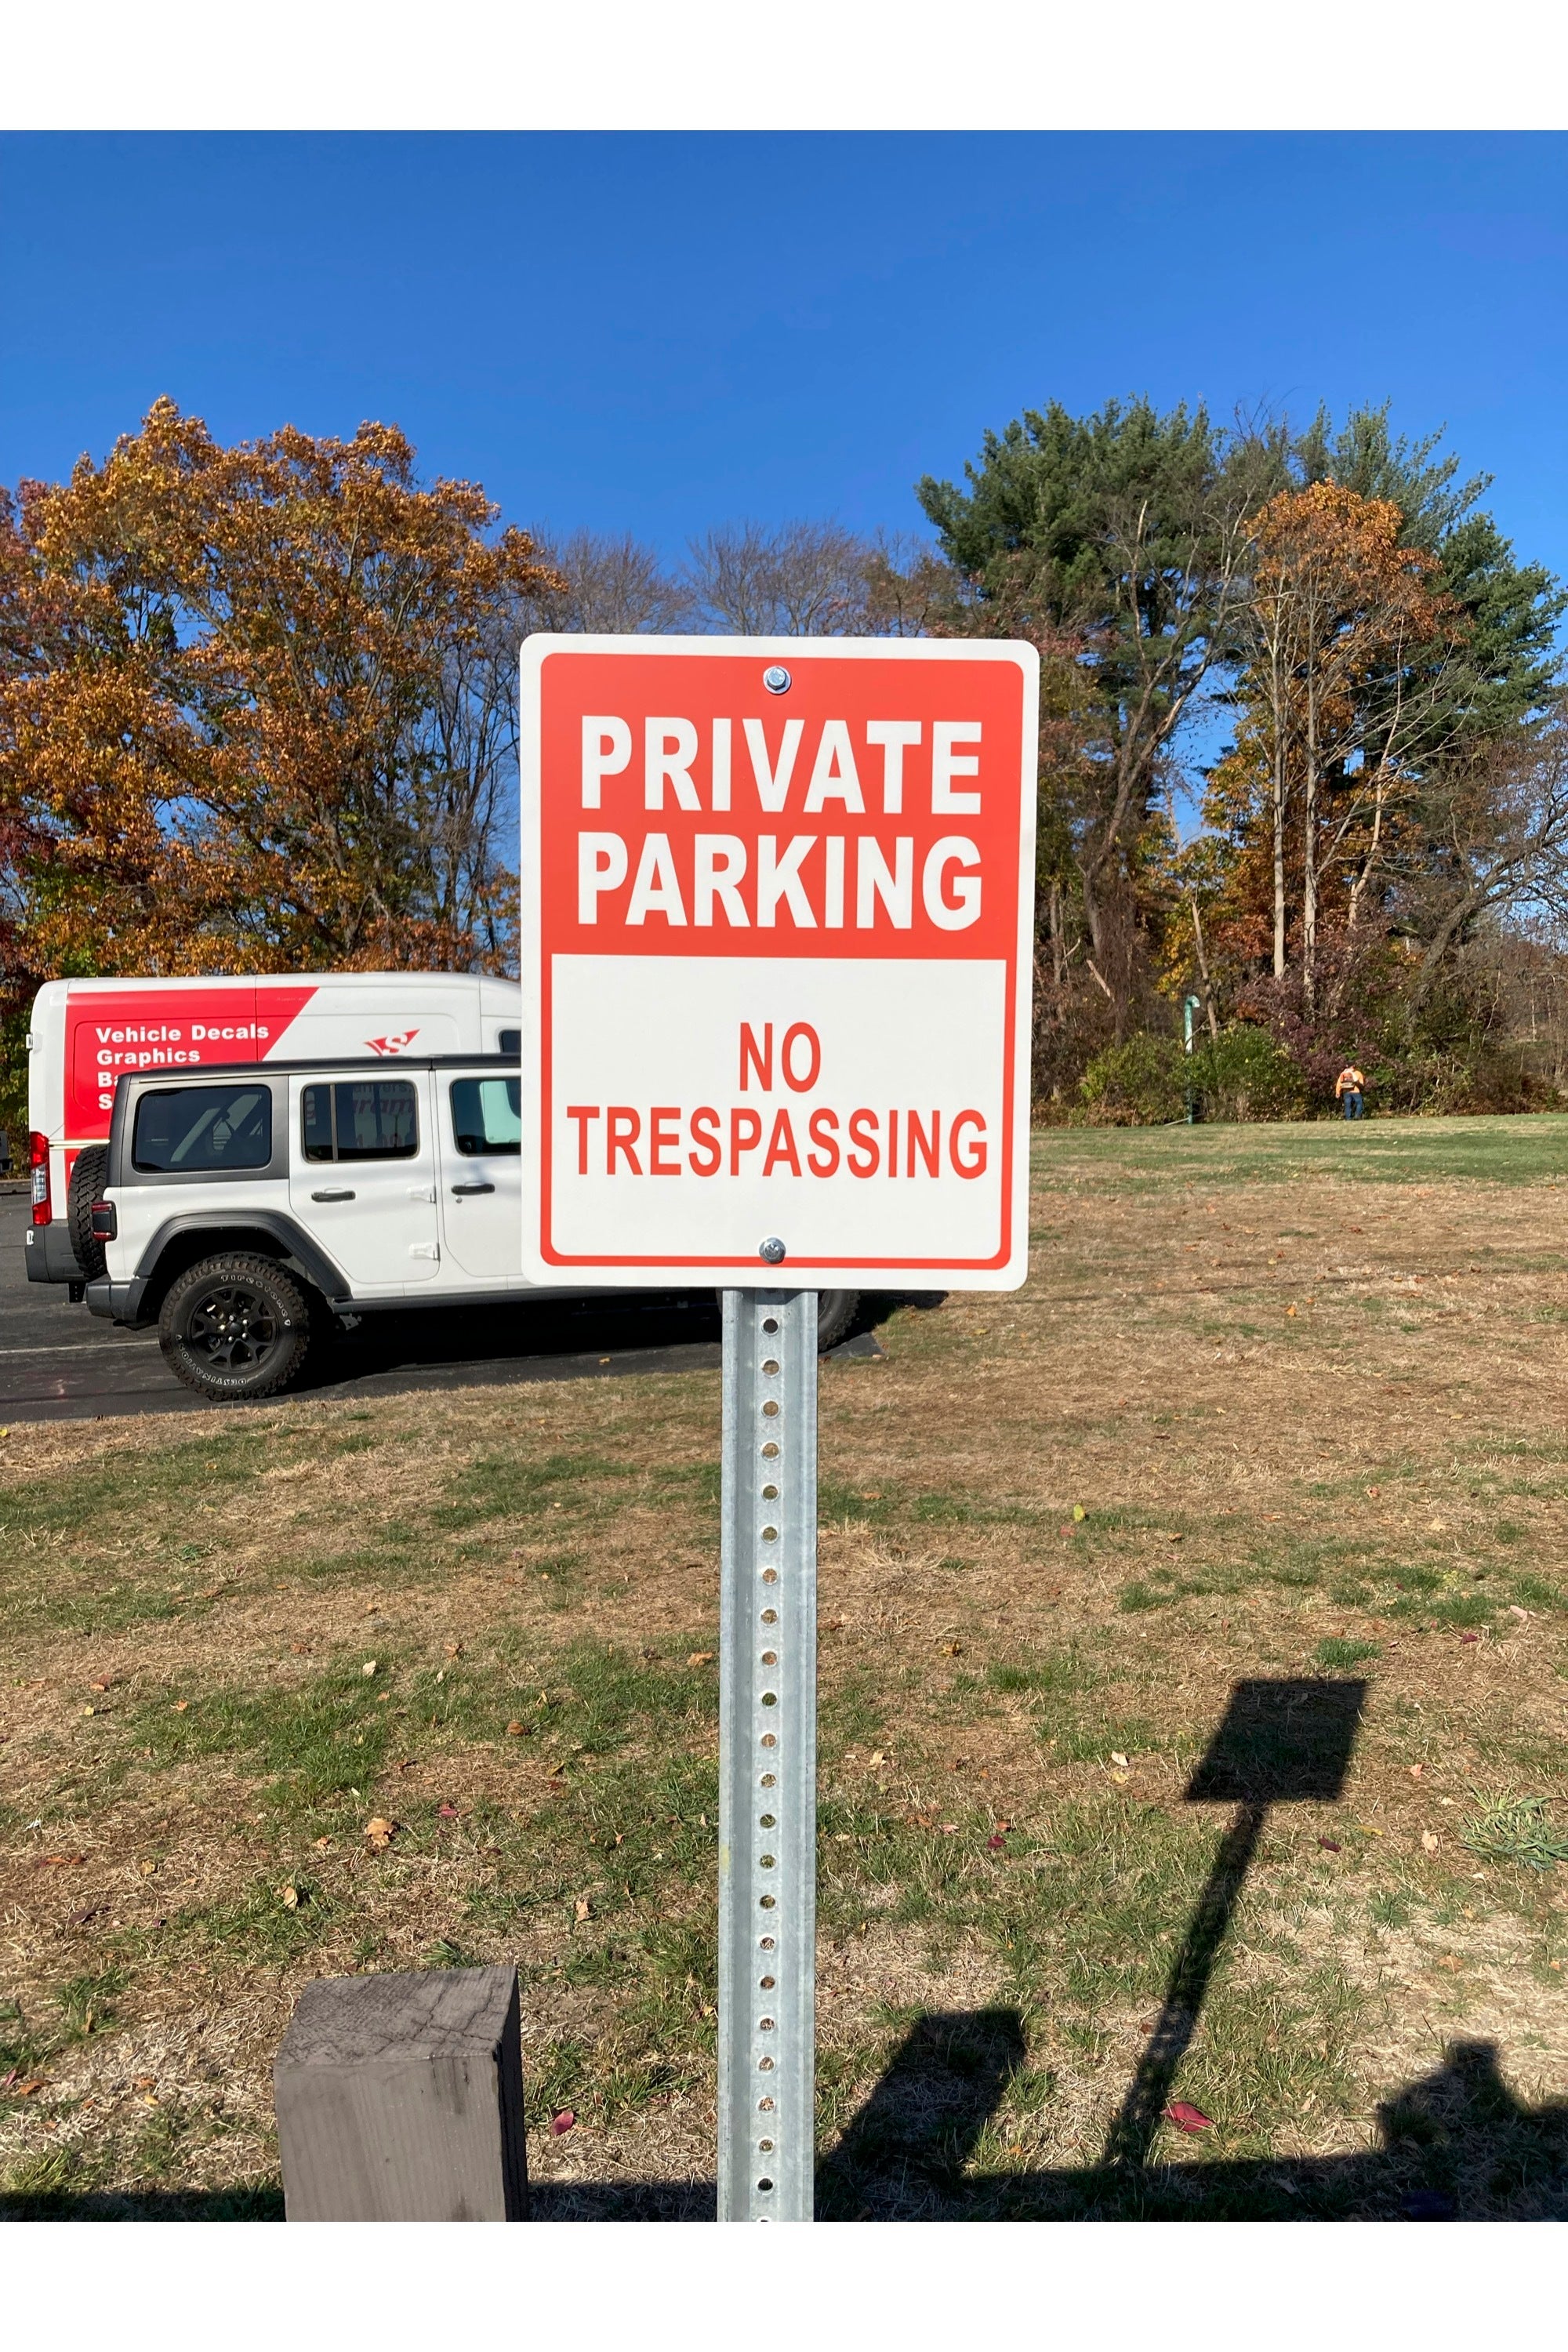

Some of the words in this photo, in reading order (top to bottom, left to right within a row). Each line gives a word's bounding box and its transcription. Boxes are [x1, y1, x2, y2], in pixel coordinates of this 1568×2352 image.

[582, 715, 982, 815] PRIVATE
[578, 831, 982, 931] PARKING
[95, 1025, 182, 1044] Vehicle
[191, 1023, 269, 1040] Decals
[96, 1047, 201, 1067] Graphics
[739, 1022, 822, 1094] NO
[97, 1071, 118, 1087] B
[566, 1105, 988, 1180] TRESPASSING
